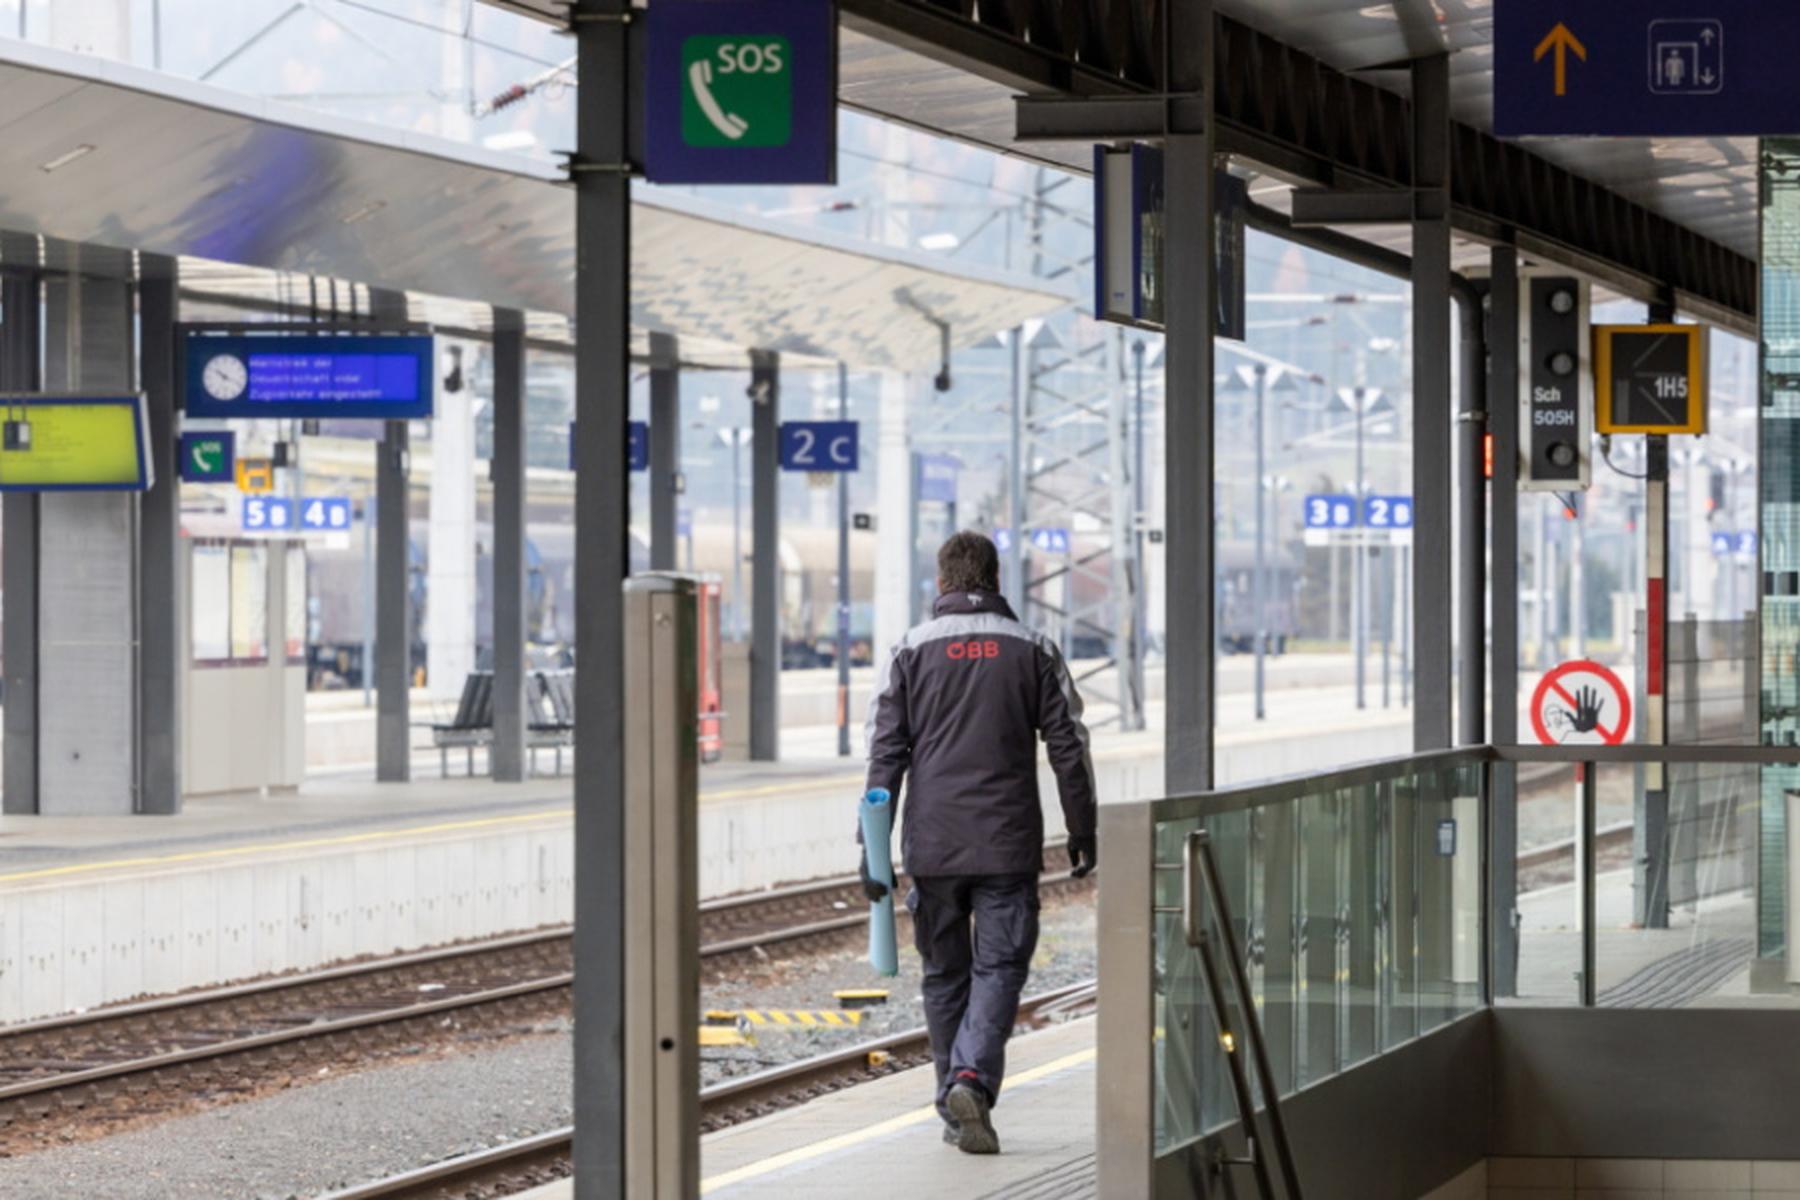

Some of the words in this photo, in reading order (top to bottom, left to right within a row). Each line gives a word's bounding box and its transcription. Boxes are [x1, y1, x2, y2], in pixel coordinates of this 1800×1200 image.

[717, 42, 784, 74] SOS
[1533, 386, 1562, 402] Sch
[1654, 376, 1688, 398] 1H5
[1533, 410, 1575, 425] 505H
[792, 429, 815, 463] 2
[247, 500, 265, 526] 5
[305, 500, 325, 526] 4
[1310, 499, 1328, 525] 3
[1370, 499, 1388, 525] 2
